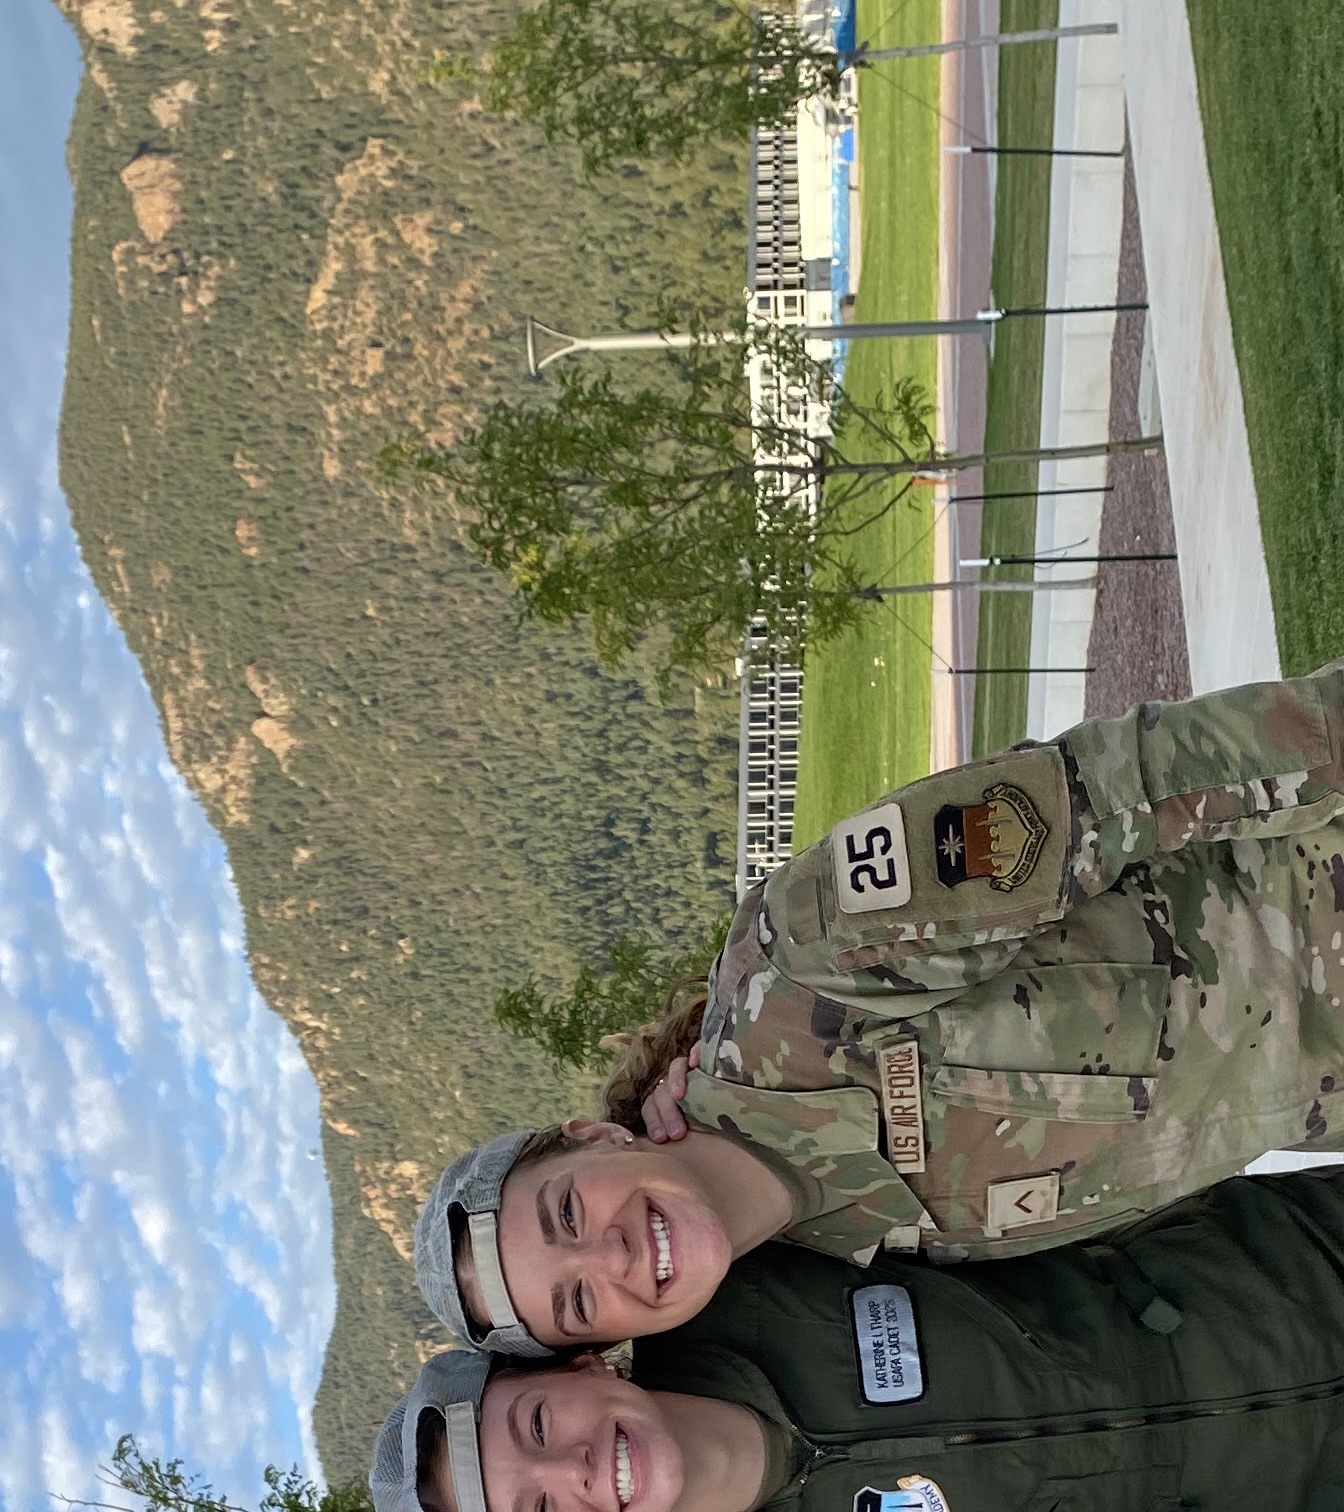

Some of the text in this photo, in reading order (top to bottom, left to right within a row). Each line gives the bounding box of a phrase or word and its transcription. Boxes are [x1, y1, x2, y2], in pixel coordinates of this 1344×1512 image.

[845, 826, 897, 893] 25
[886, 1048, 920, 1164] U.S. AIR FORCE
[868, 1300, 883, 1331] THARP
[887, 1327, 900, 1356] CADET
[872, 1339, 889, 1389] KATHERINE
[890, 1358, 904, 1388] USAFA
